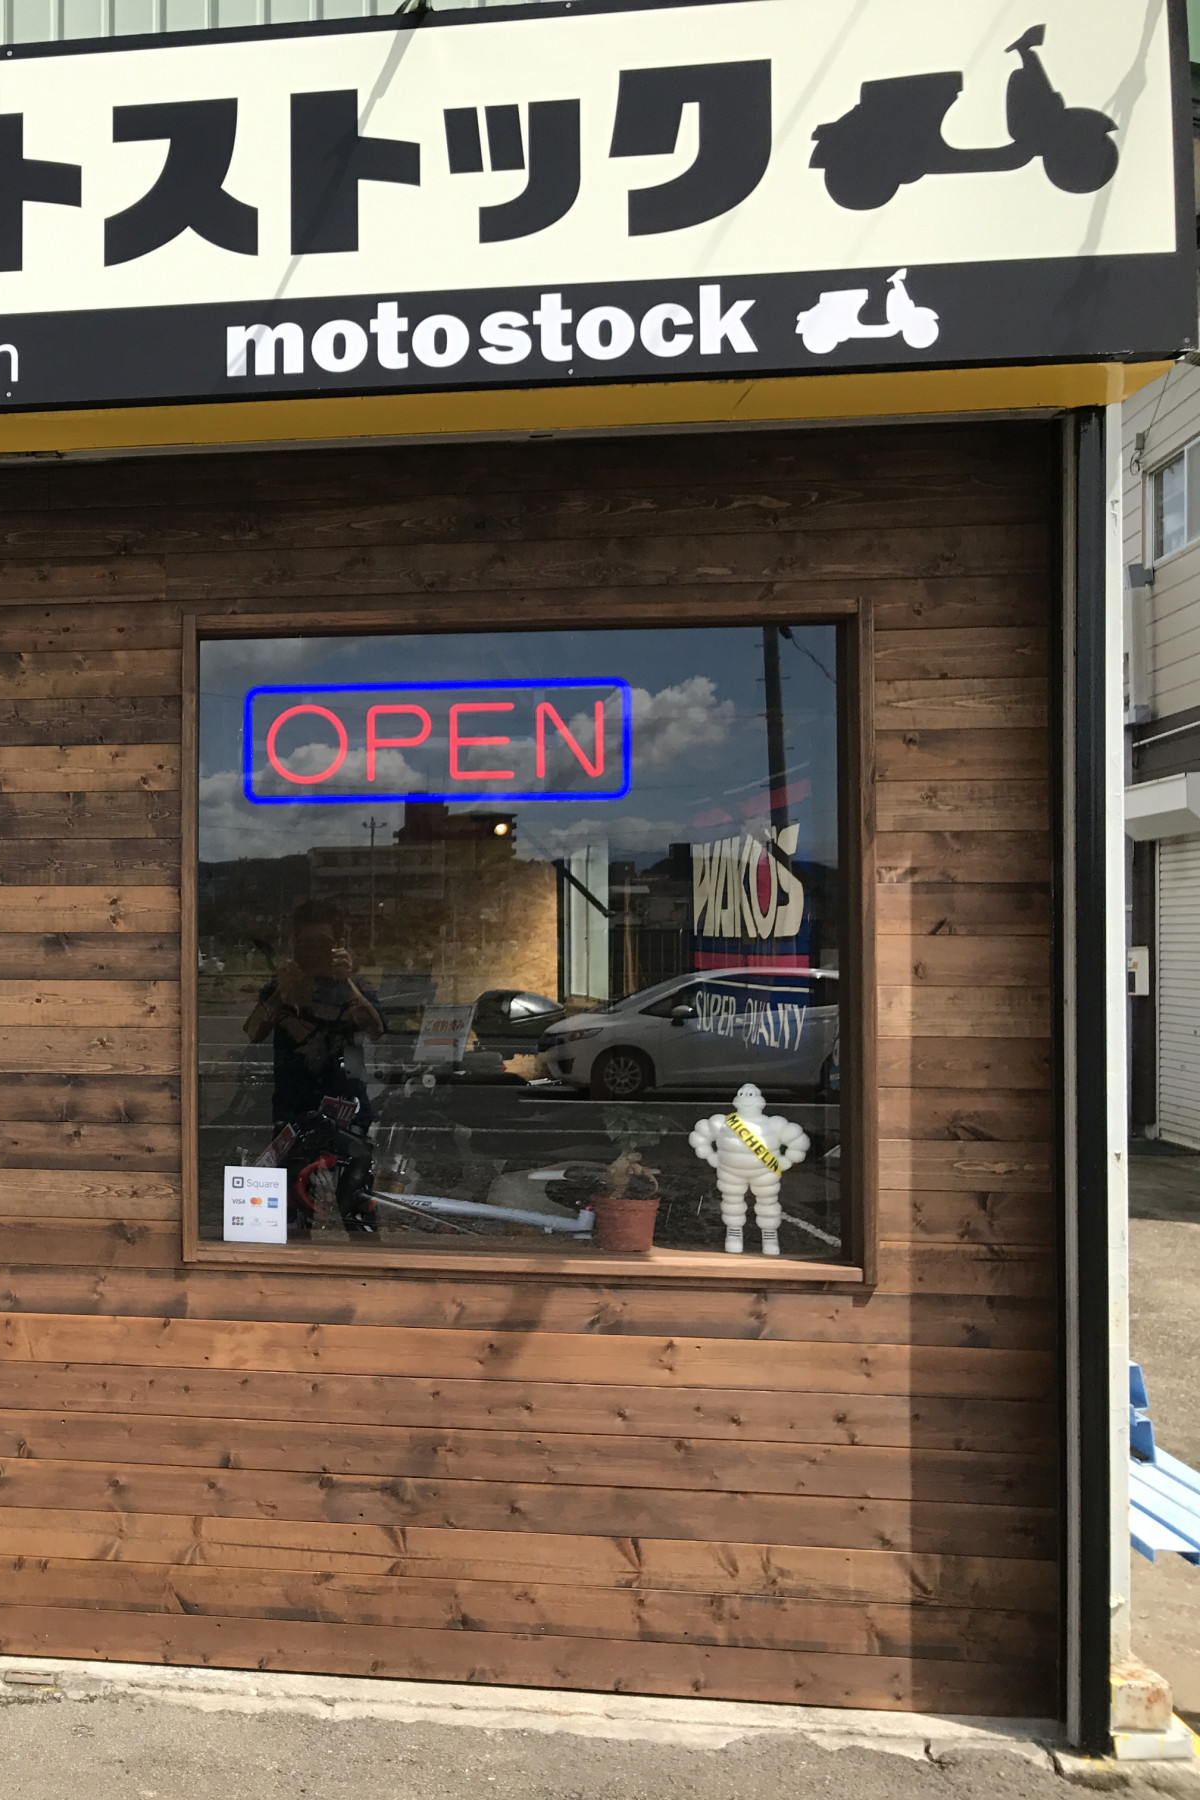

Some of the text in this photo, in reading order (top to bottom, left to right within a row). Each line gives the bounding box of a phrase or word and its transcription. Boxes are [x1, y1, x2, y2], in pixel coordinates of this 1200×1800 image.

[226, 284, 759, 378] motostock
[266, 700, 605, 785] OPEN
[727, 1114, 780, 1173] MICHELIN
[246, 1178, 279, 1190] Square
